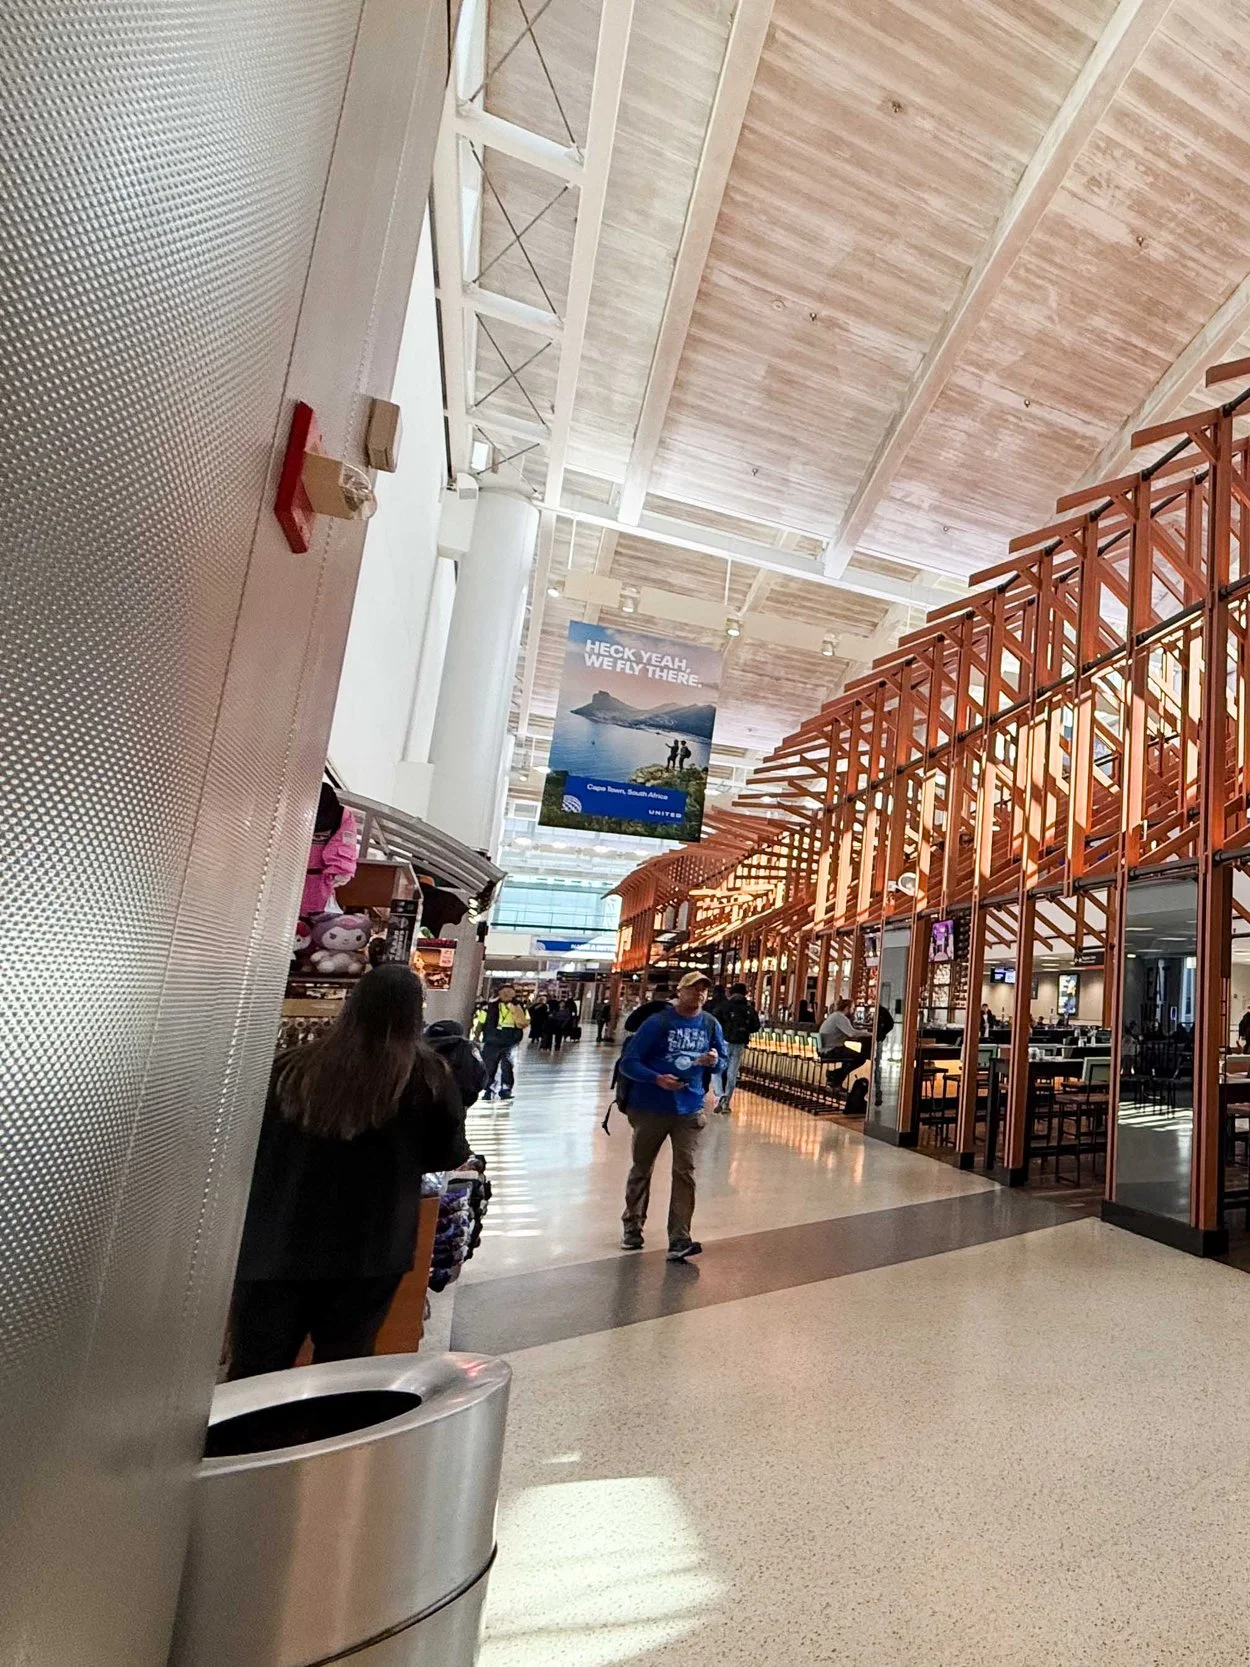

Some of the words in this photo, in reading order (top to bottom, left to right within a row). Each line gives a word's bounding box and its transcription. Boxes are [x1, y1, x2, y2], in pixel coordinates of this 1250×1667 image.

[586, 640, 636, 660] HECK
[640, 650, 690, 673] YEAH,
[584, 653, 613, 670] WE
[616, 660, 642, 675] FLY
[647, 666, 702, 688] THERE.
[587, 783, 606, 792] Cape
[607, 786, 626, 795] Town,
[627, 789, 647, 797] South
[648, 791, 668, 800] Africa
[648, 809, 682, 818] UNITED
